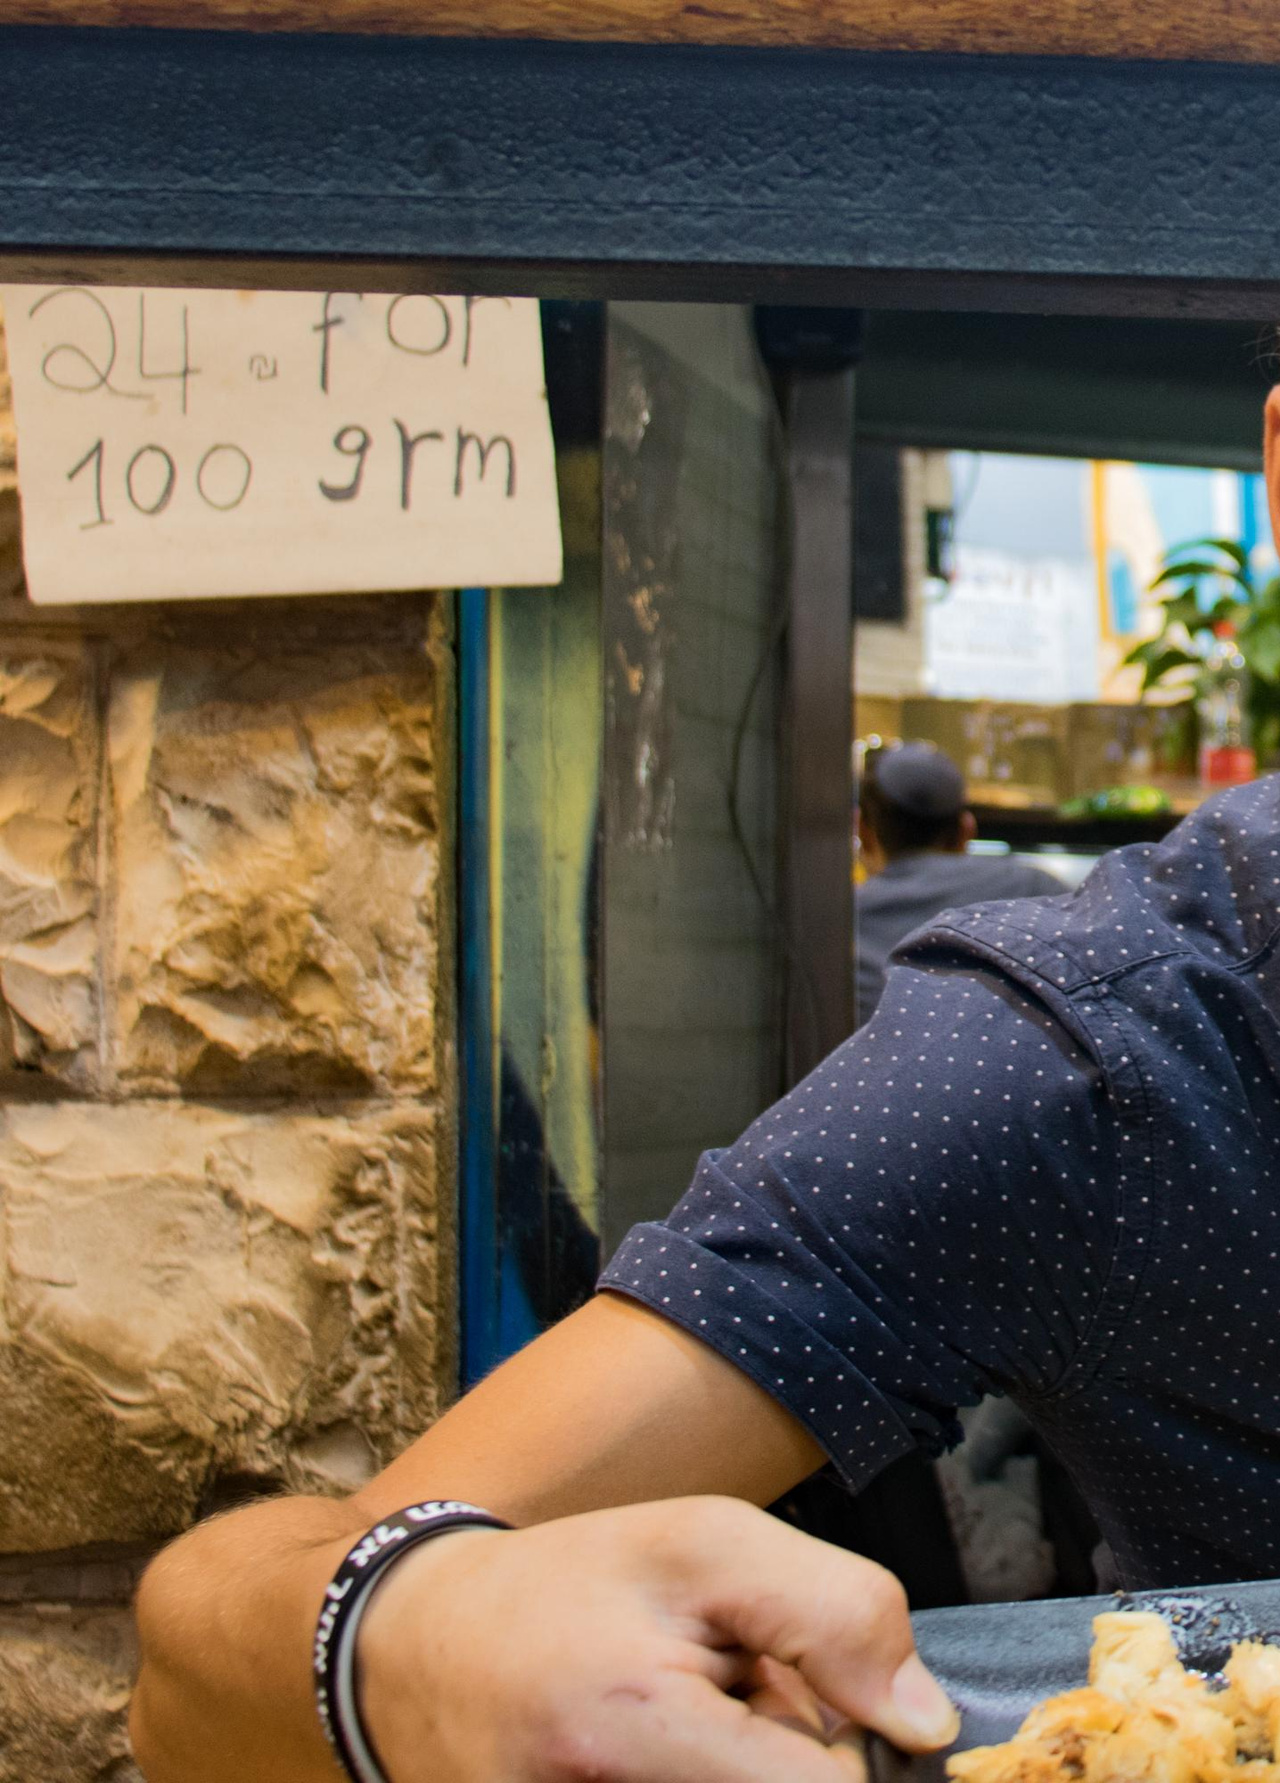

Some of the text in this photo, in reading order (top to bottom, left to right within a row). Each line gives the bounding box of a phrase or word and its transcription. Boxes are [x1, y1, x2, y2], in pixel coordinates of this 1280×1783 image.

[29, 287, 202, 415] 24
[312, 291, 512, 394] for
[66, 417, 516, 531] 100 grm
